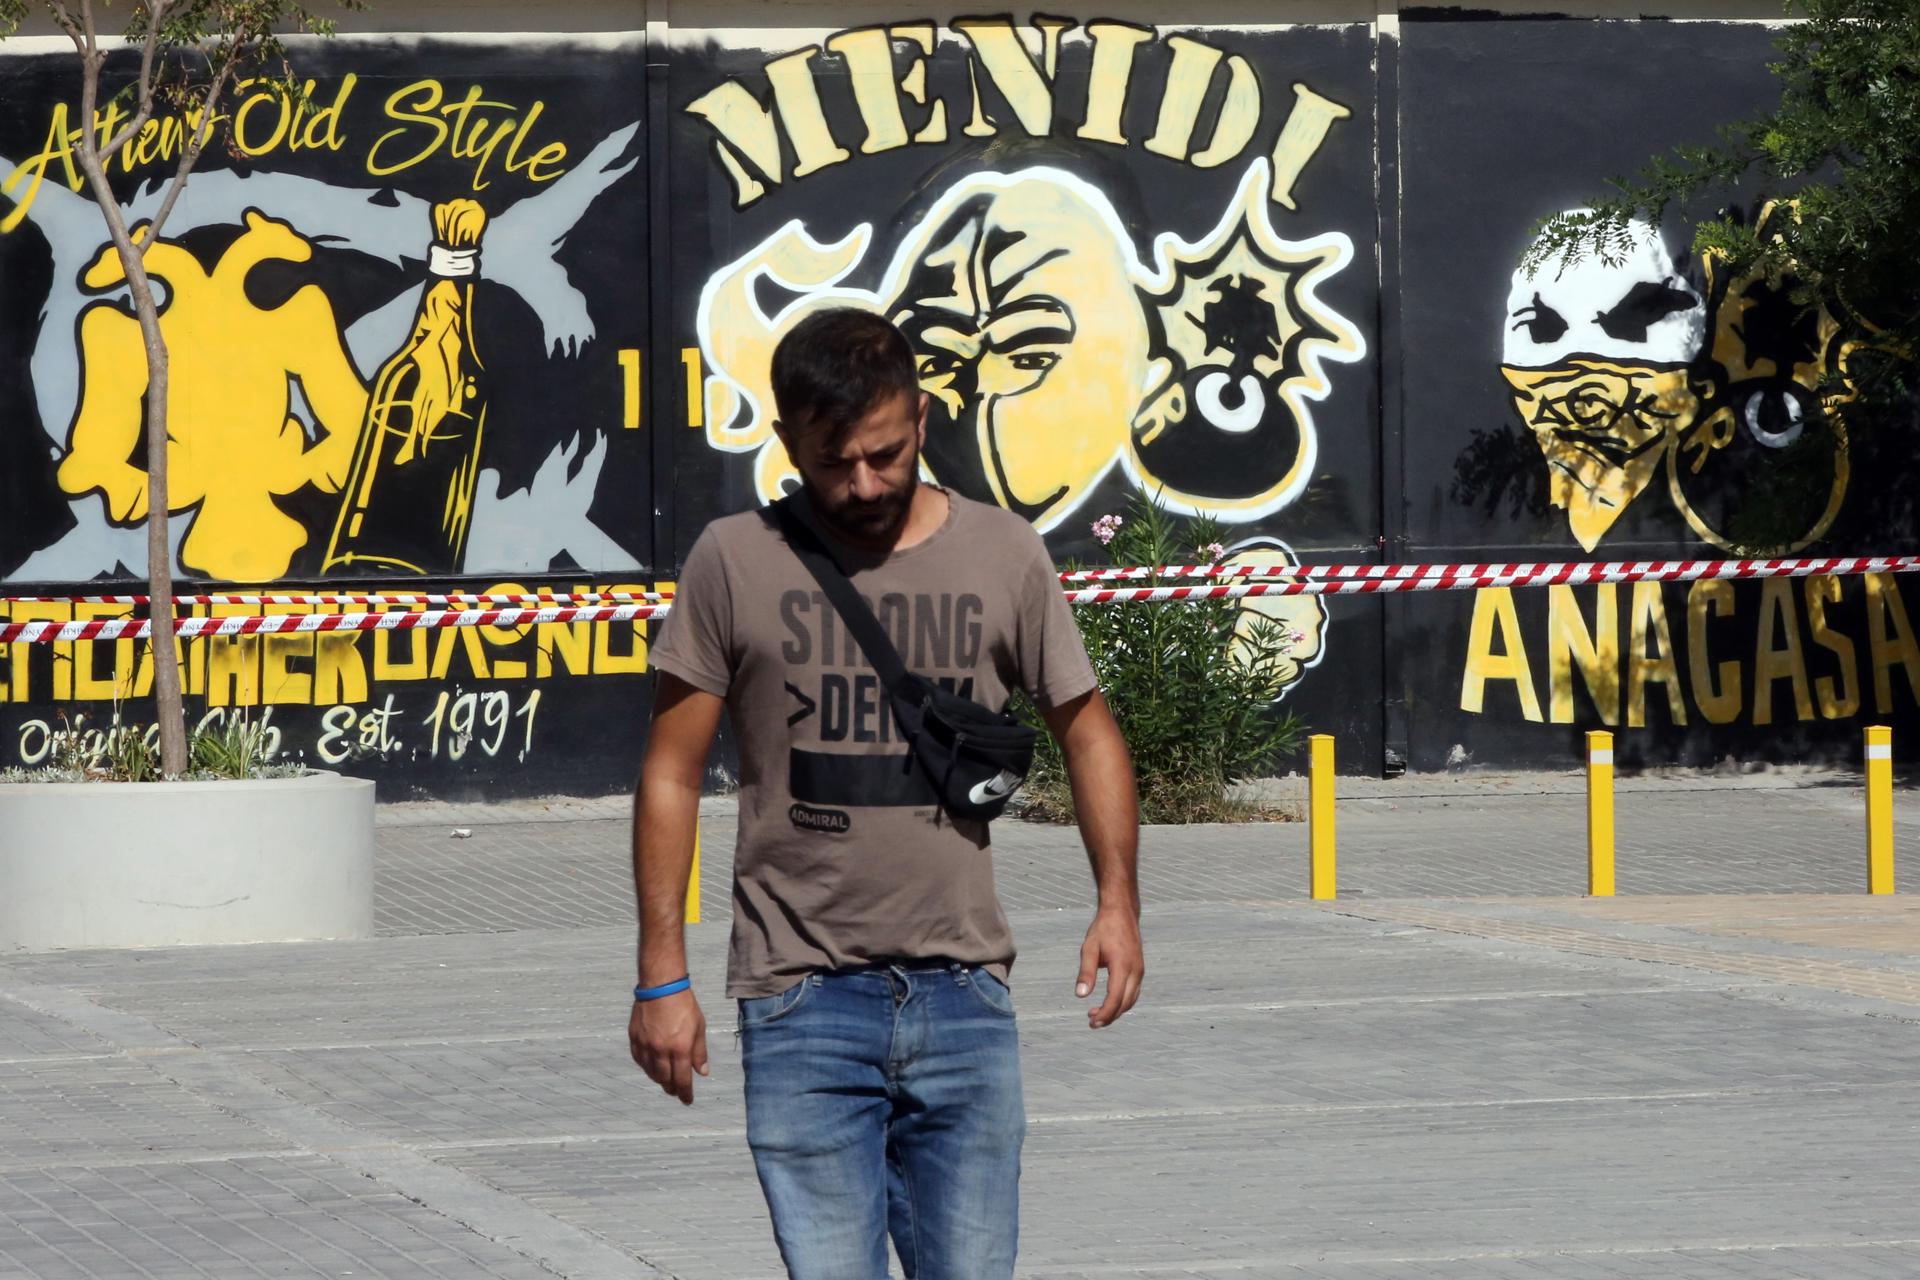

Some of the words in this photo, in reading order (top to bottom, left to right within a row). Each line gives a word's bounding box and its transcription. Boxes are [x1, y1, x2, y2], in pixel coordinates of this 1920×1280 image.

[234, 72, 357, 156] Old
[366, 79, 567, 191] Style
[684, 15, 1352, 211] MENIDI
[780, 589, 984, 670] STONG
[18, 706, 186, 769] Origina
[423, 689, 541, 761] 1991
[820, 673, 975, 743] DEN
[791, 807, 848, 829] ADMIRAL
